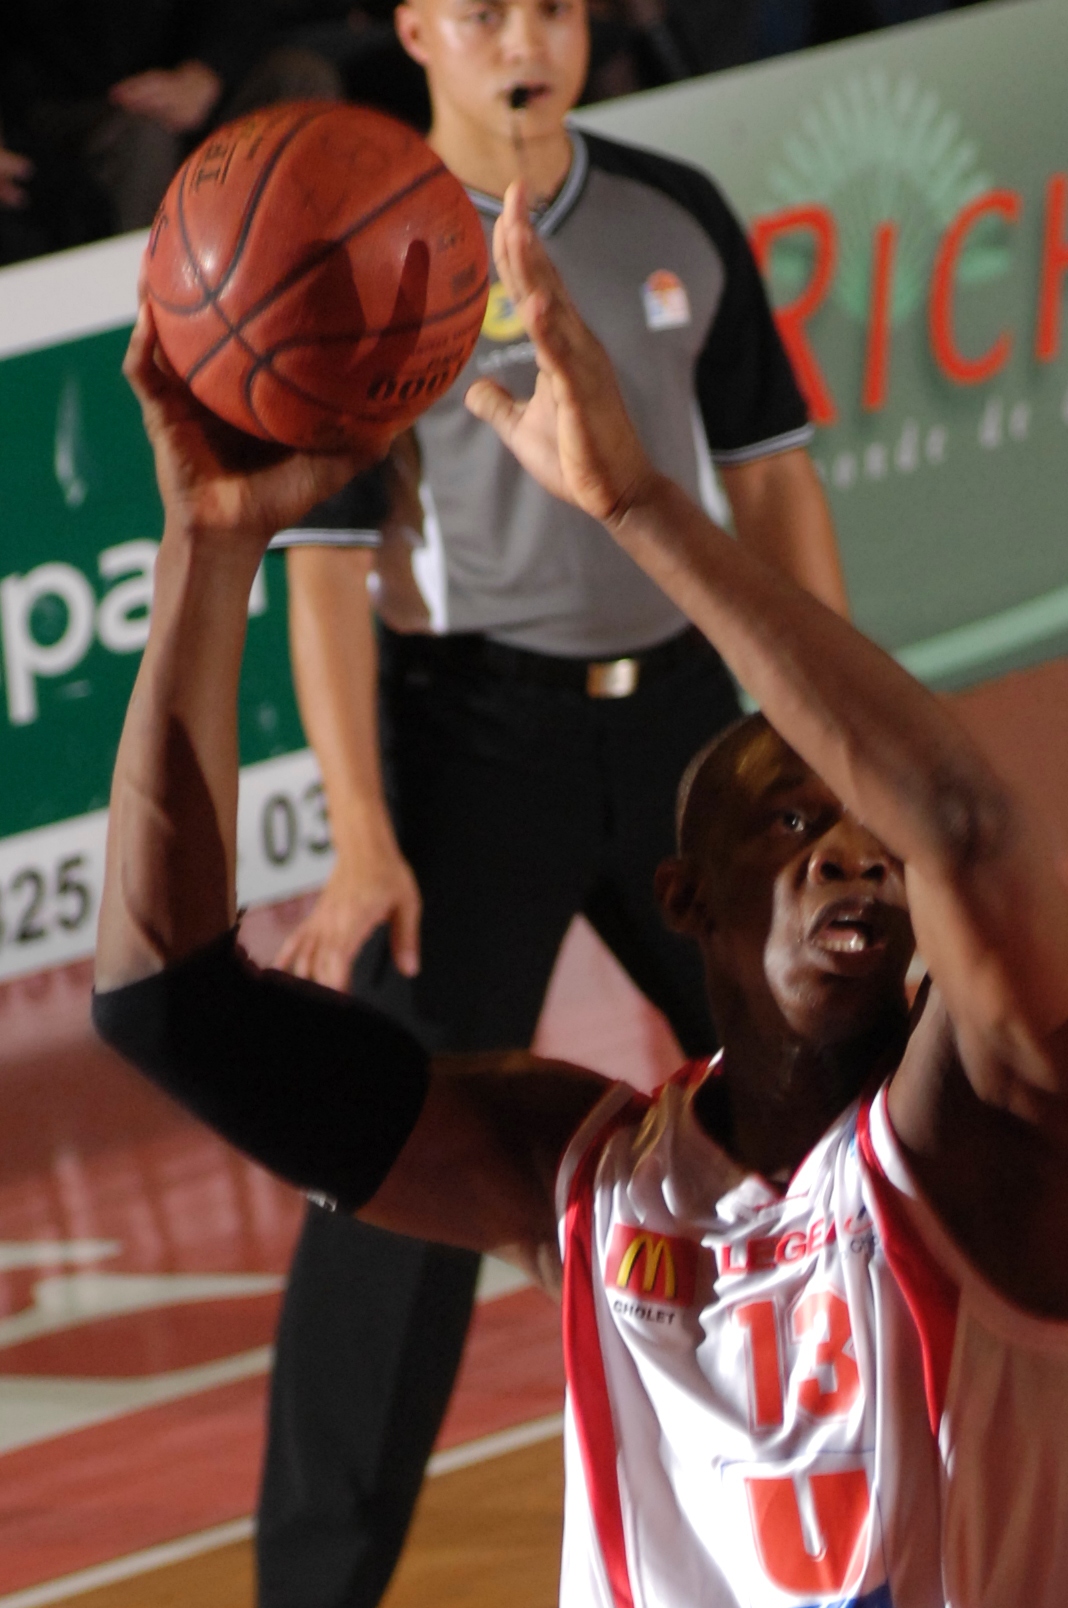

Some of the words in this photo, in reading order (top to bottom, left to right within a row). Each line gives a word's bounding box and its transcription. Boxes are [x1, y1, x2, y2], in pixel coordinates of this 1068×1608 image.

[0, 855, 92, 944] 25
[613, 1300, 676, 1325] CHOLET
[733, 1284, 863, 1430] 13
